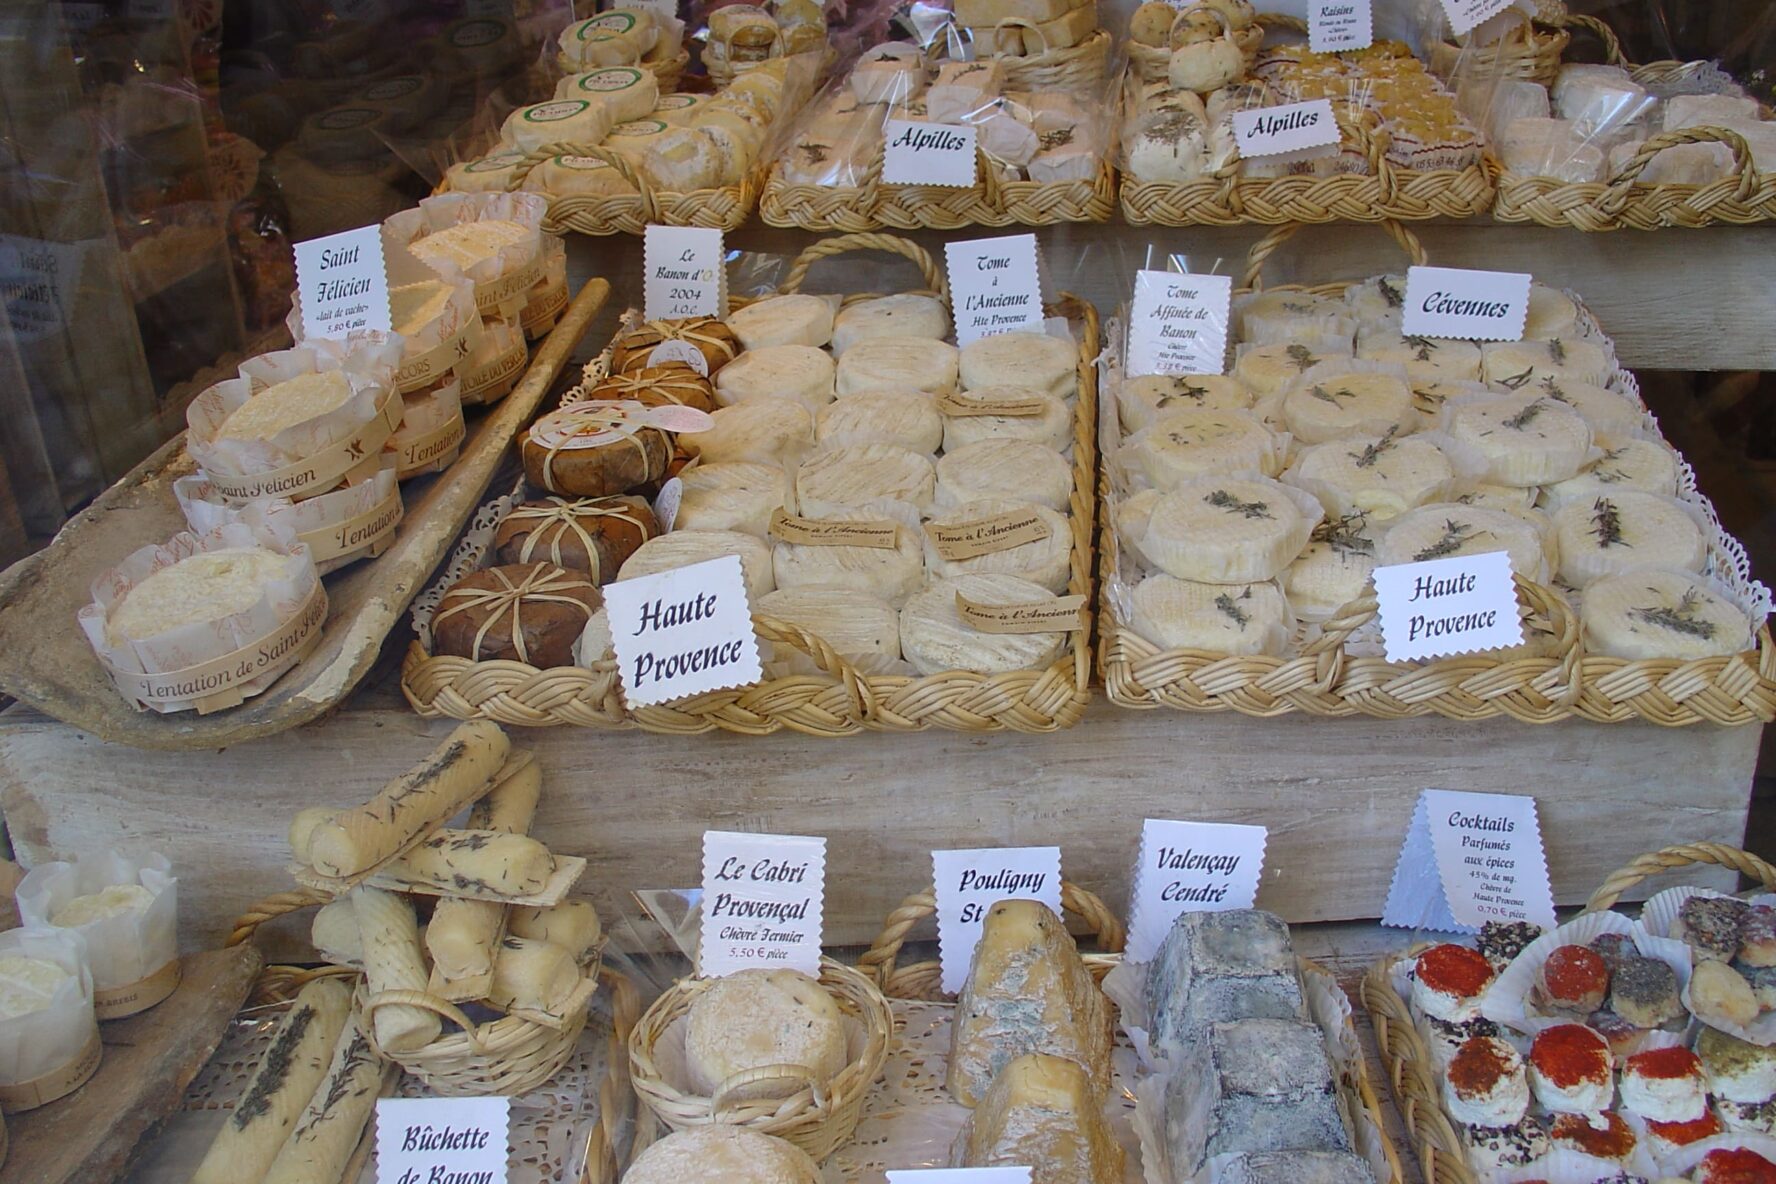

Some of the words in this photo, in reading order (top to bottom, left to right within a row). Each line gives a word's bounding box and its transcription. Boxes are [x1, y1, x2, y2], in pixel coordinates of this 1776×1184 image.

[1320, 6, 1354, 17] Raisins
[1247, 111, 1319, 138] Alpilles
[892, 127, 966, 152] Alpilles
[320, 245, 359, 270] Saint
[679, 249, 696, 262] Le
[976, 255, 1010, 271] Tome
[655, 267, 690, 281] Banon
[992, 276, 998, 287] à
[317, 277, 371, 303] Félicien
[669, 288, 702, 300] 2004
[1167, 285, 1199, 299] Tome
[966, 293, 1030, 311] l'Ancienne
[1422, 291, 1510, 318] Cévennes
[335, 307, 343, 318] de
[971, 316, 989, 327] Hte
[991, 314, 1027, 326] Provence
[1150, 304, 1191, 320] Affinée
[1194, 308, 1209, 320] de
[346, 320, 351, 329] €
[1160, 324, 1198, 339] Banon
[404, 428, 462, 465] Tentation
[336, 509, 396, 549] Tentation
[823, 526, 894, 536] l'Ancienne
[935, 531, 963, 543] Tome
[966, 532, 974, 541] à
[976, 517, 1038, 540] l'Ancienne
[1408, 573, 1476, 601] Haute
[632, 592, 717, 636] Haute
[999, 612, 1008, 621] à
[1408, 610, 1497, 642] Provence
[140, 669, 231, 699] Tentation
[235, 661, 254, 679] de
[256, 632, 300, 668] Saint
[634, 640, 743, 688] Provence
[1448, 811, 1515, 833] Cocktails
[1462, 836, 1511, 851] Parfumés
[714, 856, 746, 881] Le
[750, 859, 808, 882] Cabri
[1158, 847, 1240, 876] Valençay
[1464, 855, 1483, 865] aux
[1486, 856, 1515, 869] épices
[959, 868, 1046, 894] Pouligny
[1469, 870, 1489, 880] 45%
[1491, 873, 1500, 881] de
[1161, 881, 1229, 903] Cendré
[1503, 886, 1512, 894] de
[711, 893, 810, 924] Provençal
[1472, 892, 1494, 903] Haute
[1496, 896, 1525, 908] Provence
[960, 903, 984, 923] St
[1500, 907, 1507, 917] €
[1508, 909, 1527, 919] pièce
[720, 926, 758, 941] Chèvre
[760, 928, 804, 943] Fermier
[757, 947, 765, 957] €
[766, 949, 788, 960] pièce
[401, 1125, 490, 1152] Bûchette
[396, 1167, 421, 1184] de
[427, 1165, 494, 1184] Banon
